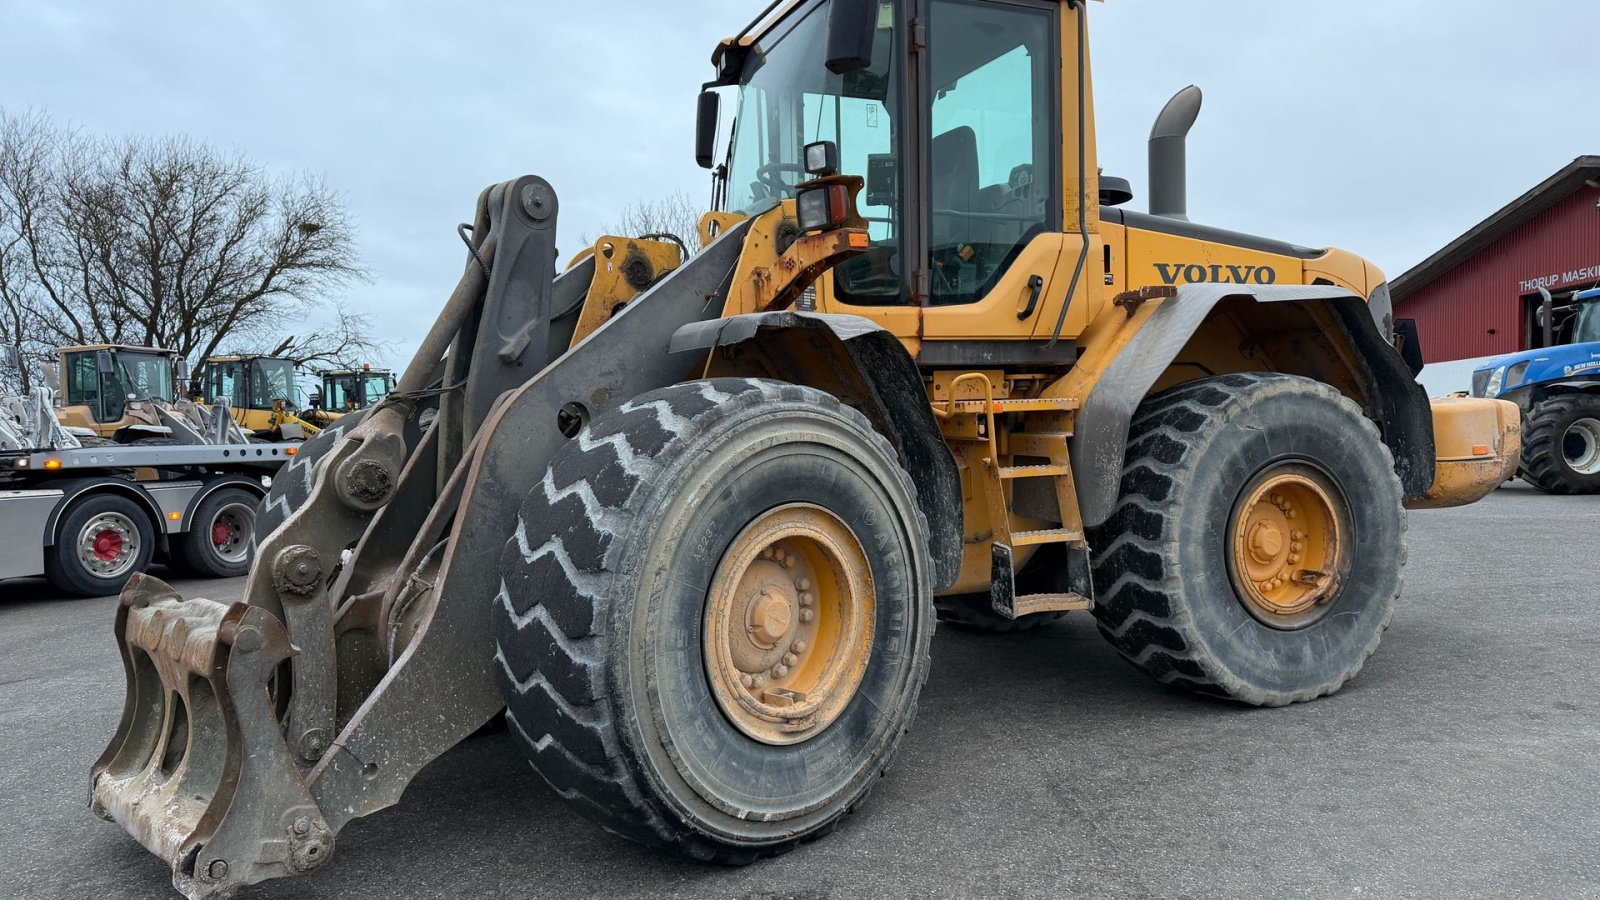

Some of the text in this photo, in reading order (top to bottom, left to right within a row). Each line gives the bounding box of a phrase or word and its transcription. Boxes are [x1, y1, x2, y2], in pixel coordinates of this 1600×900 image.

[1153, 263, 1276, 285] VOLVO
[1519, 265, 1600, 291] THORUP MASKI
